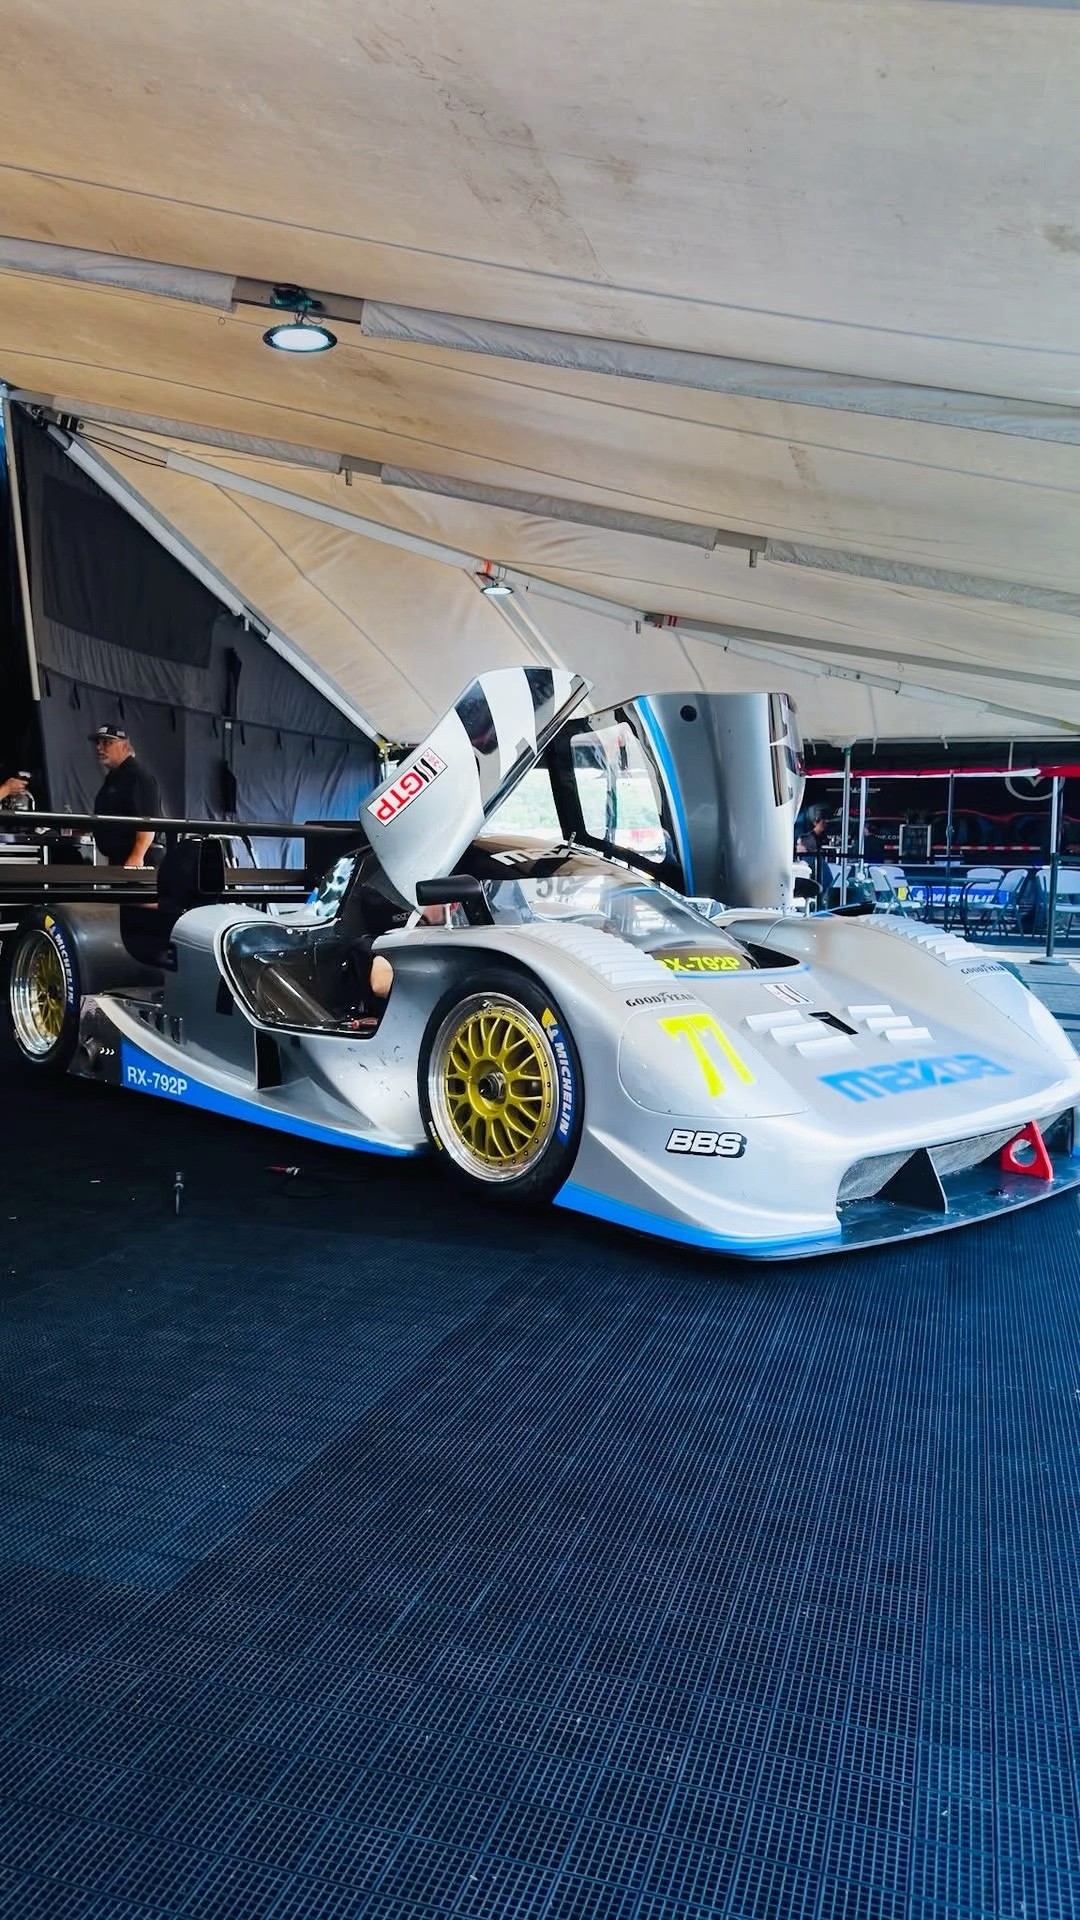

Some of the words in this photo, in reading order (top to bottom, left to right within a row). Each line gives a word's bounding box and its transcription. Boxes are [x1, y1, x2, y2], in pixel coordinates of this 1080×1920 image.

[377, 772, 423, 821] GTP
[54, 932, 74, 1004] MICHELIN
[127, 1066, 187, 1095] RX-792P
[657, 1013, 754, 1098] 77
[817, 1052, 1015, 1103] mazda
[554, 1042, 574, 1136] MICHELIN
[666, 1128, 747, 1158] BBS
